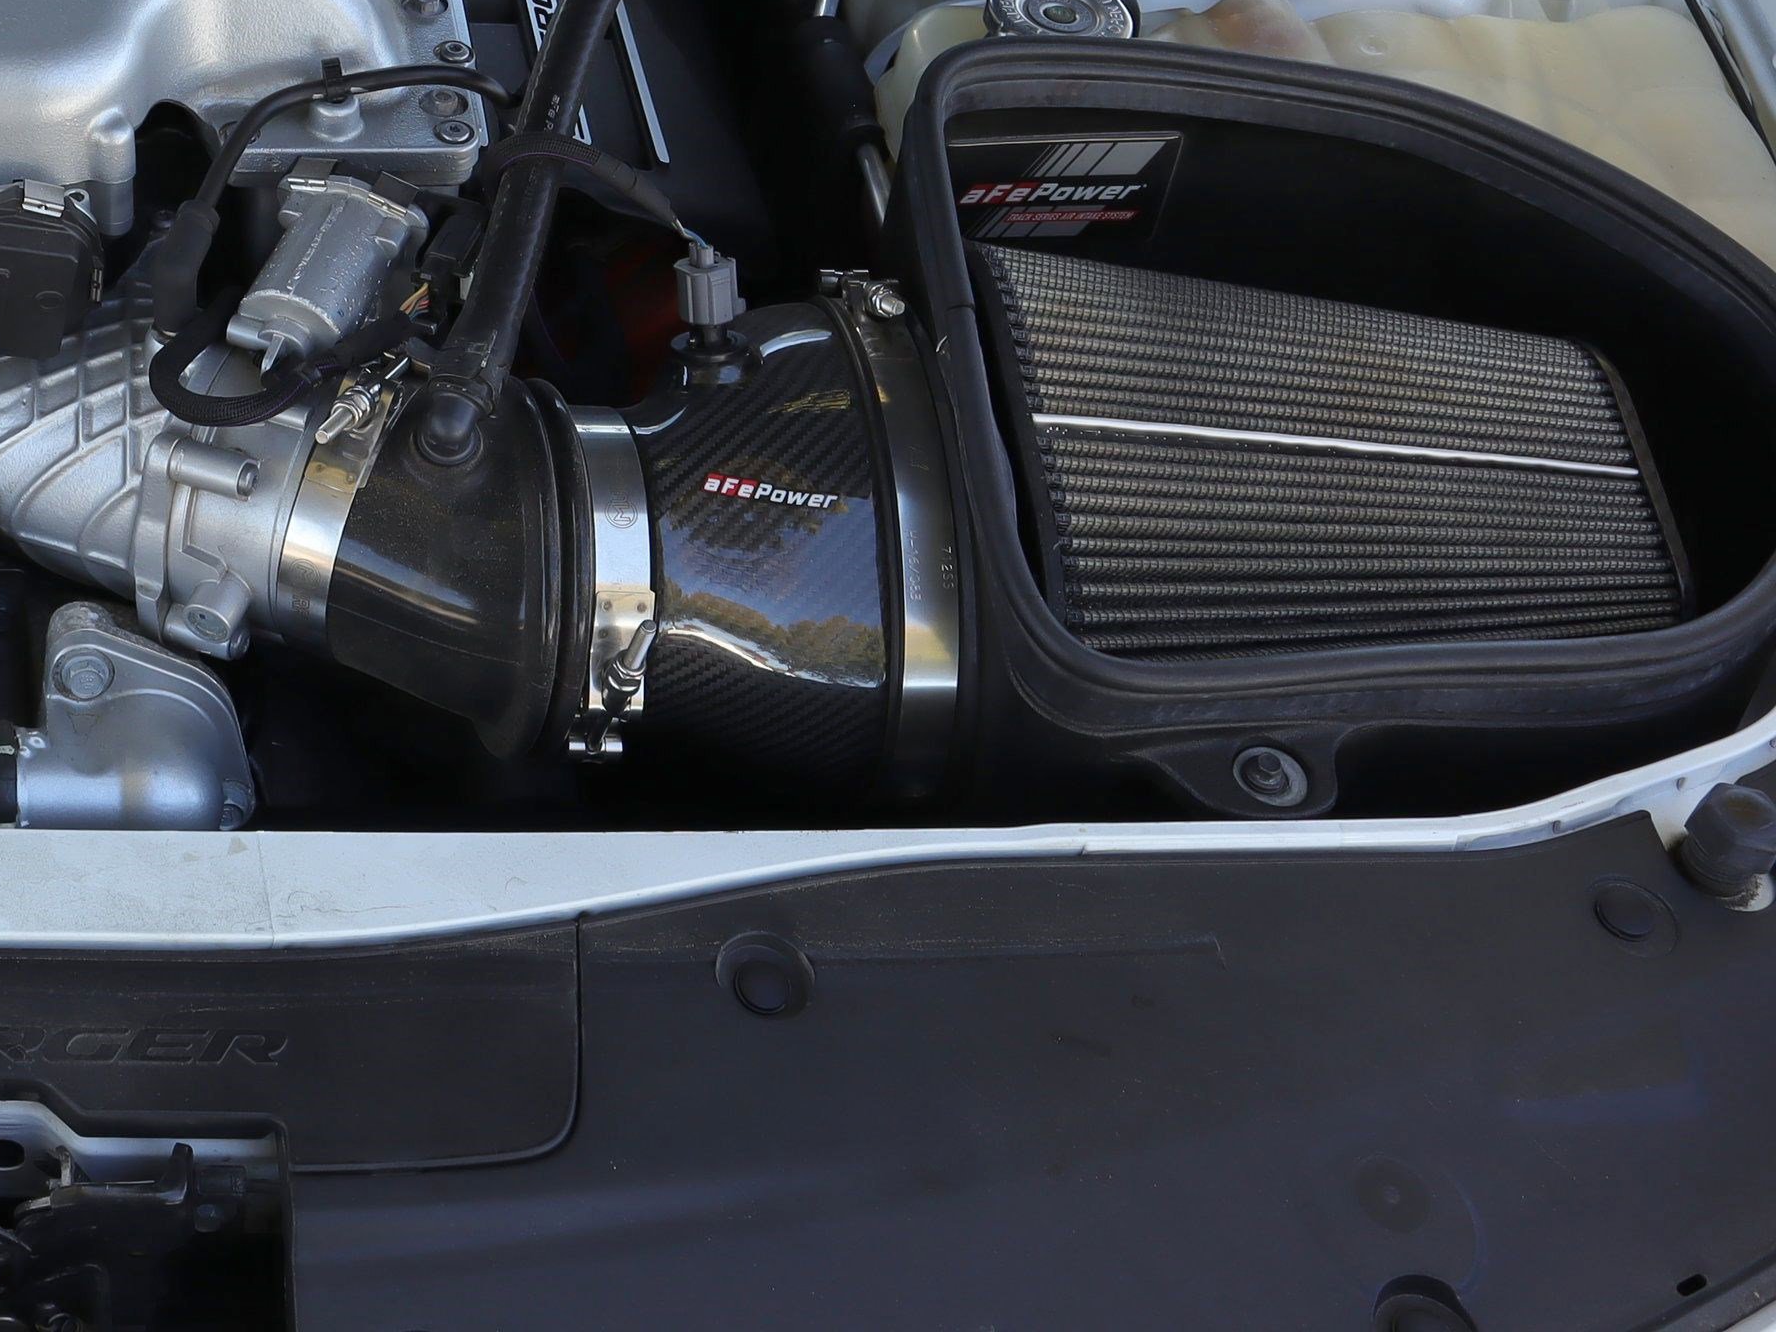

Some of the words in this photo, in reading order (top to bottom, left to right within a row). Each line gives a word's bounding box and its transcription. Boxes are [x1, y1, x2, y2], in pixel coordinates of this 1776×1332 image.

[959, 182, 1141, 204] aFePower
[1007, 212, 1030, 221] TRACK
[1032, 212, 1059, 221] SERIES
[1061, 212, 1074, 220] AIR
[1076, 212, 1101, 220] INTAKE
[1102, 211, 1134, 220] SYSTEM
[703, 477, 838, 509] aFePower
